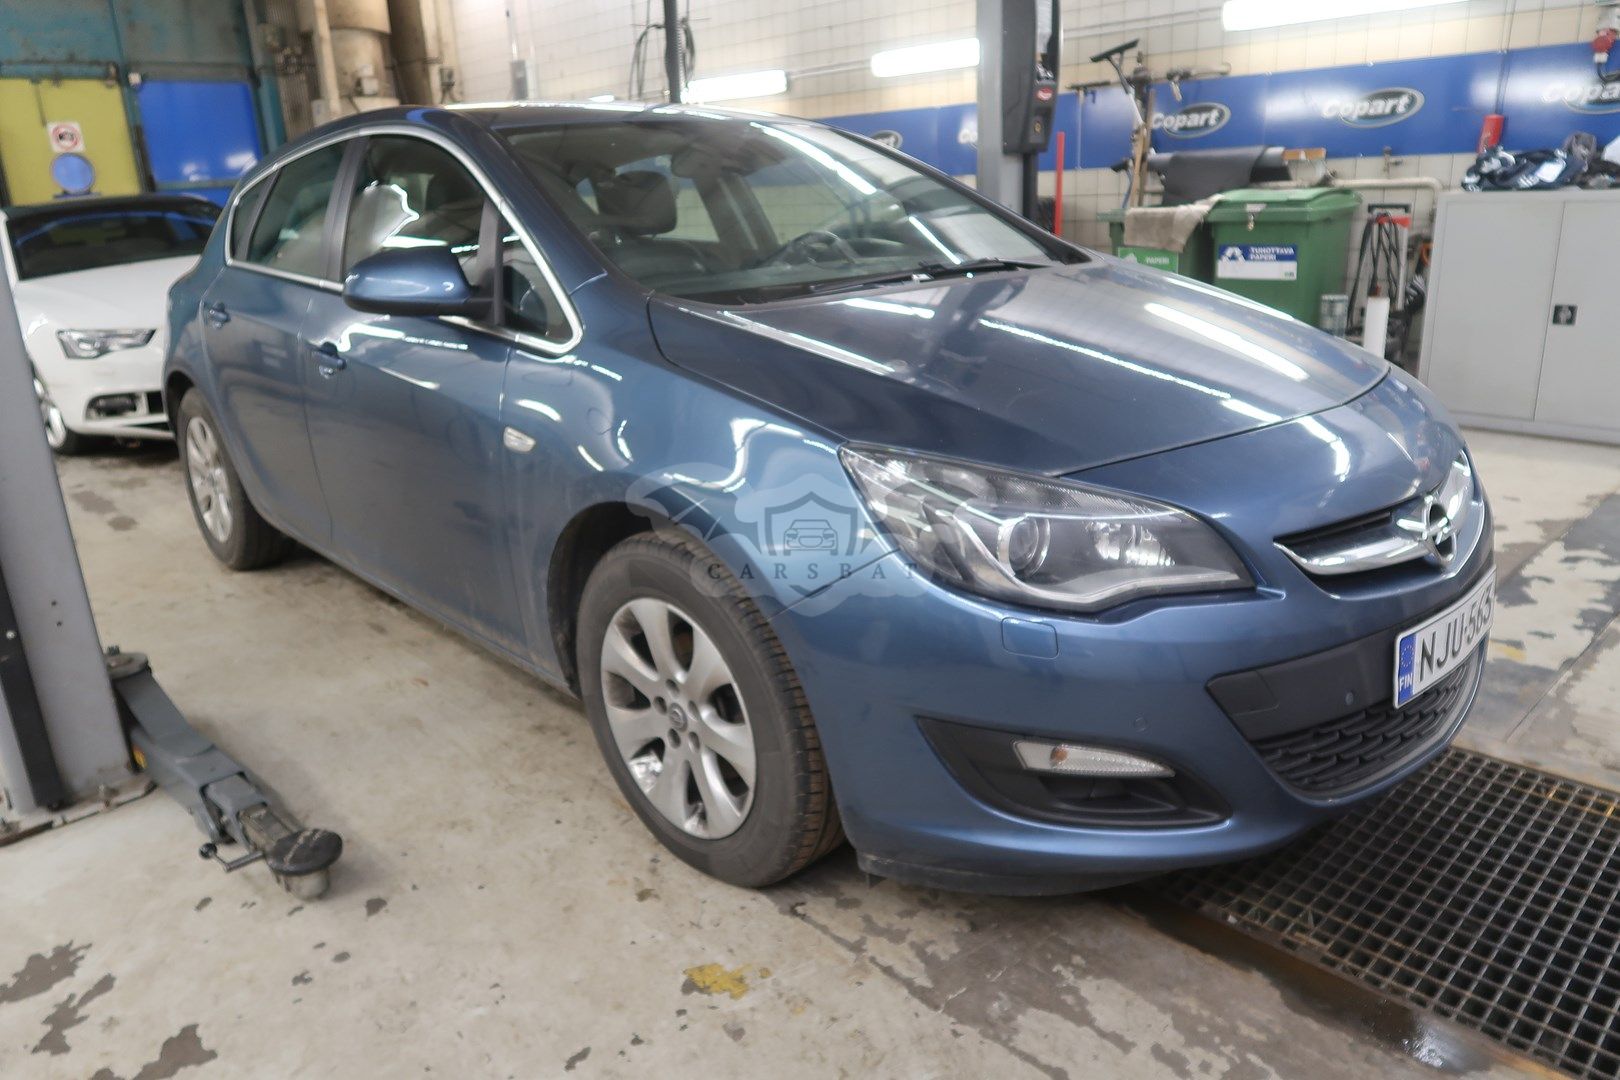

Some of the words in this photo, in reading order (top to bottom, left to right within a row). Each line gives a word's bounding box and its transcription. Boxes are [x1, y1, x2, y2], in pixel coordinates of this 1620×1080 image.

[1322, 95, 1410, 119] Copart
[1152, 109, 1219, 131] Copart
[1250, 253, 1277, 261] PAPERI
[1400, 674, 1413, 691] FIN
